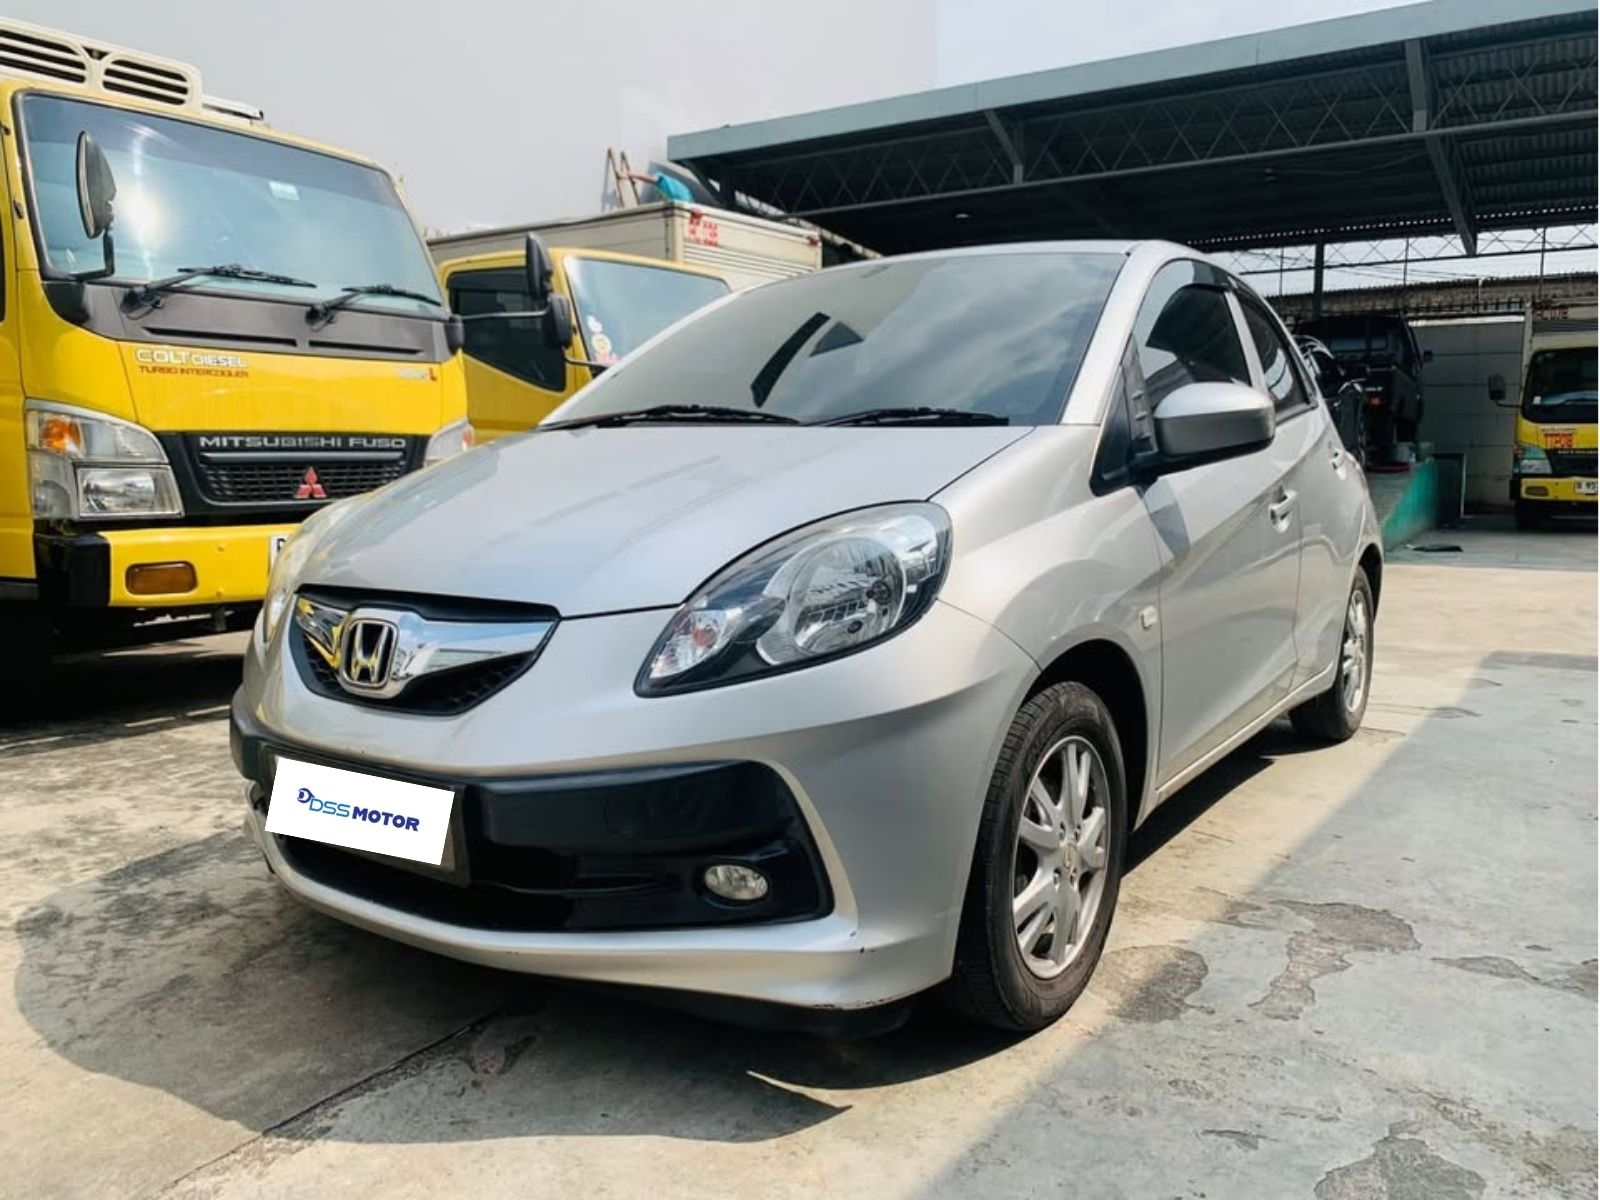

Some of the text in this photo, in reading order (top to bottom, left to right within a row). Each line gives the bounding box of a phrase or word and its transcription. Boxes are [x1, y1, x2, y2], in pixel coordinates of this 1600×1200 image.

[136, 349, 246, 367] COLT DIESEL
[139, 365, 249, 378] TURBO INTERCOOLER
[200, 436, 406, 449] MITSUBISHI FUSO
